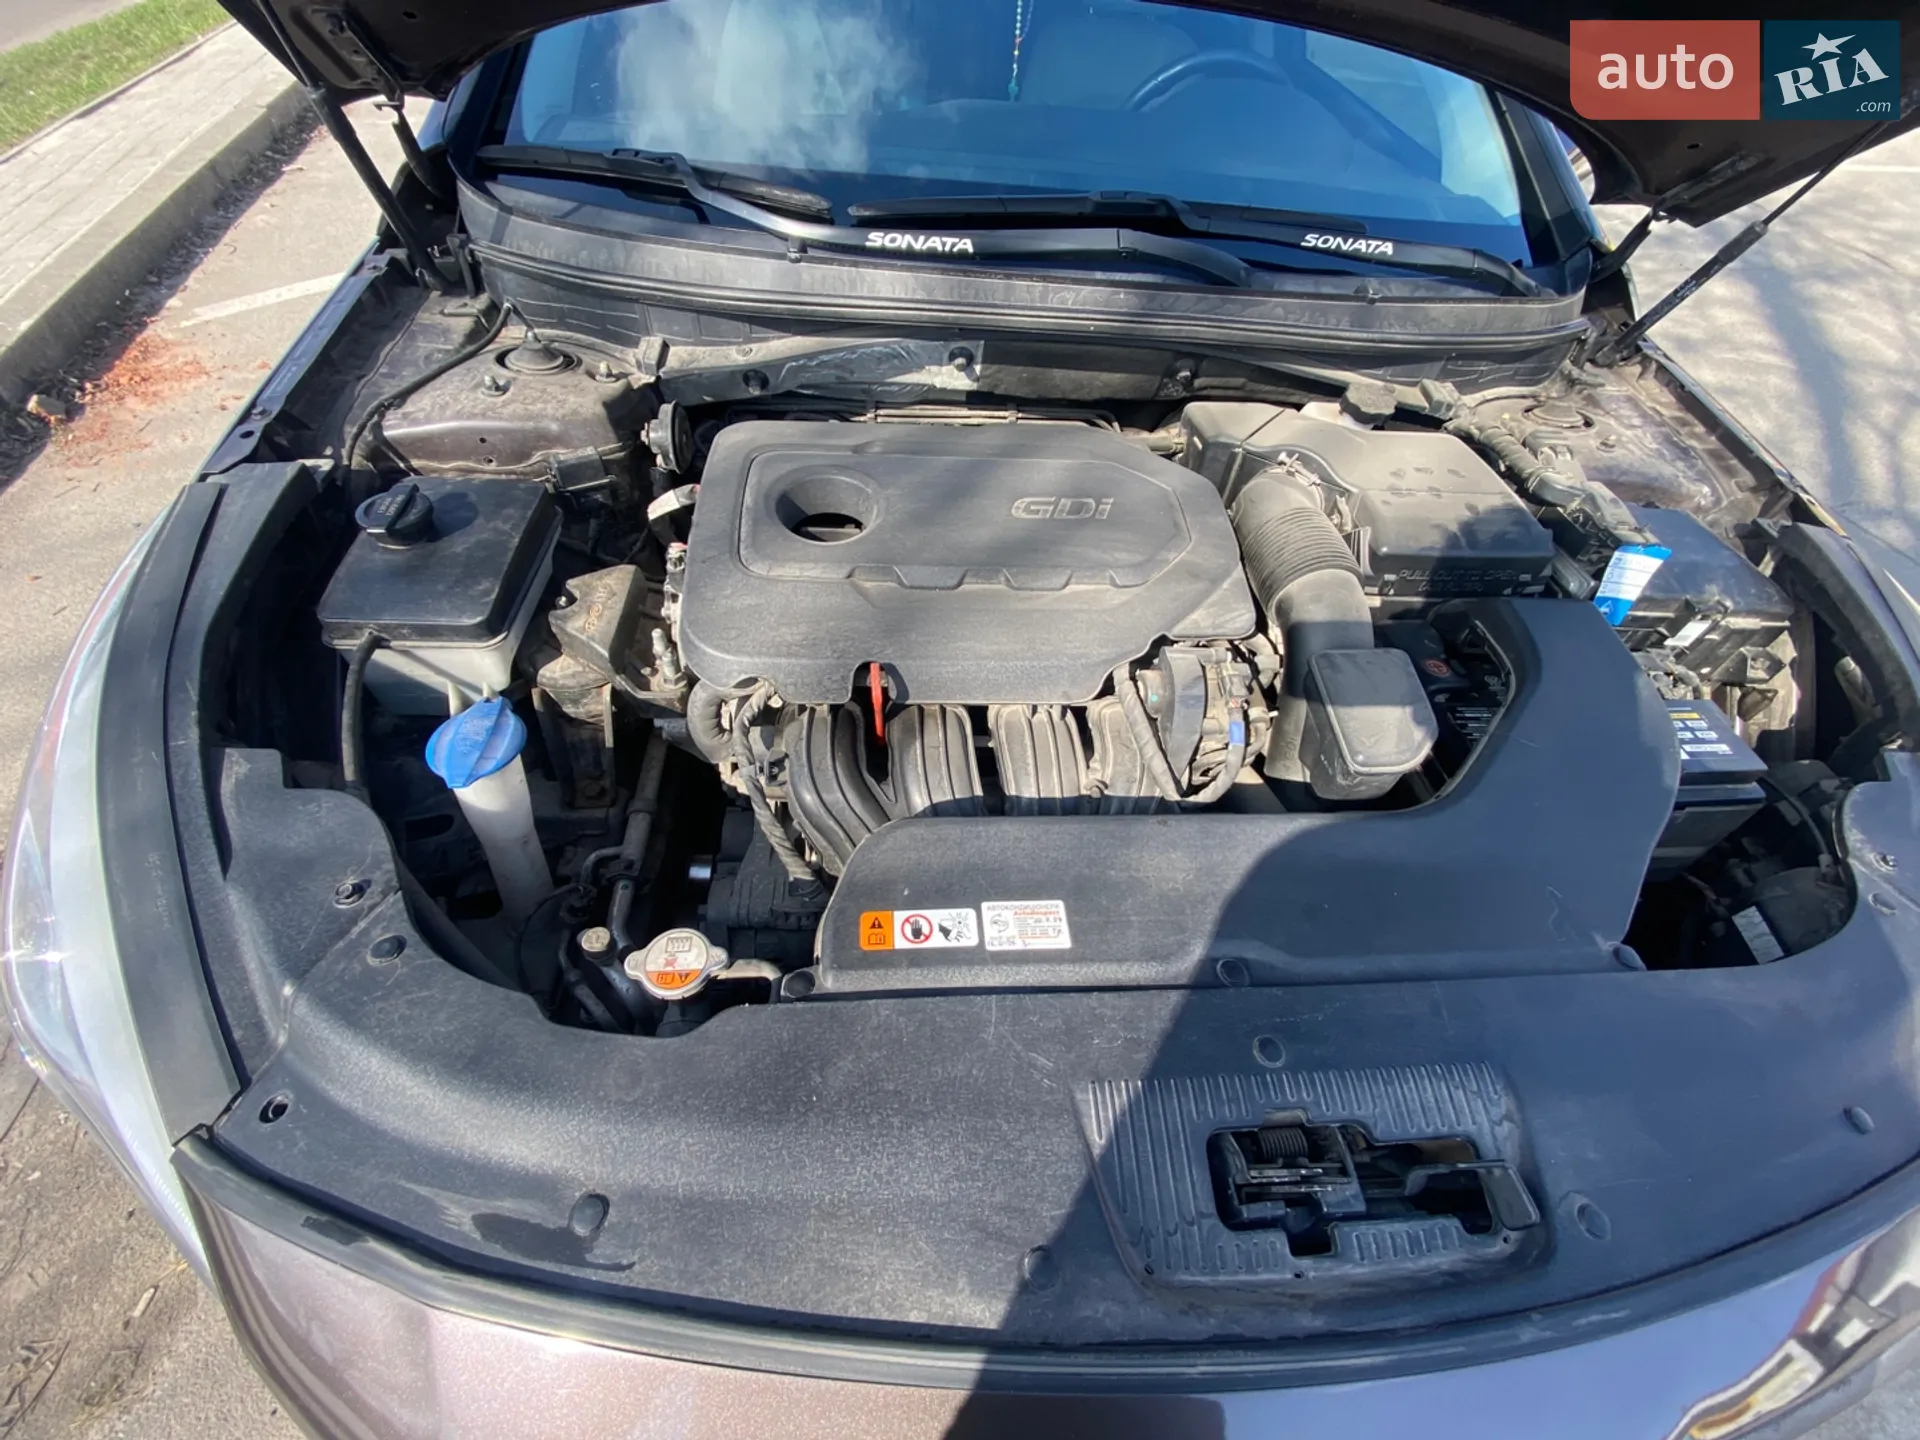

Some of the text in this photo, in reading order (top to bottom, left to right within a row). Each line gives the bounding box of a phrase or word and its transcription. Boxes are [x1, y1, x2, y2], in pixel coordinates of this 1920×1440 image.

[865, 231, 974, 254] SONATA
[1300, 233, 1394, 255] SONATA
[1010, 496, 1115, 519] GDi
[1398, 569, 1431, 580] PULL
